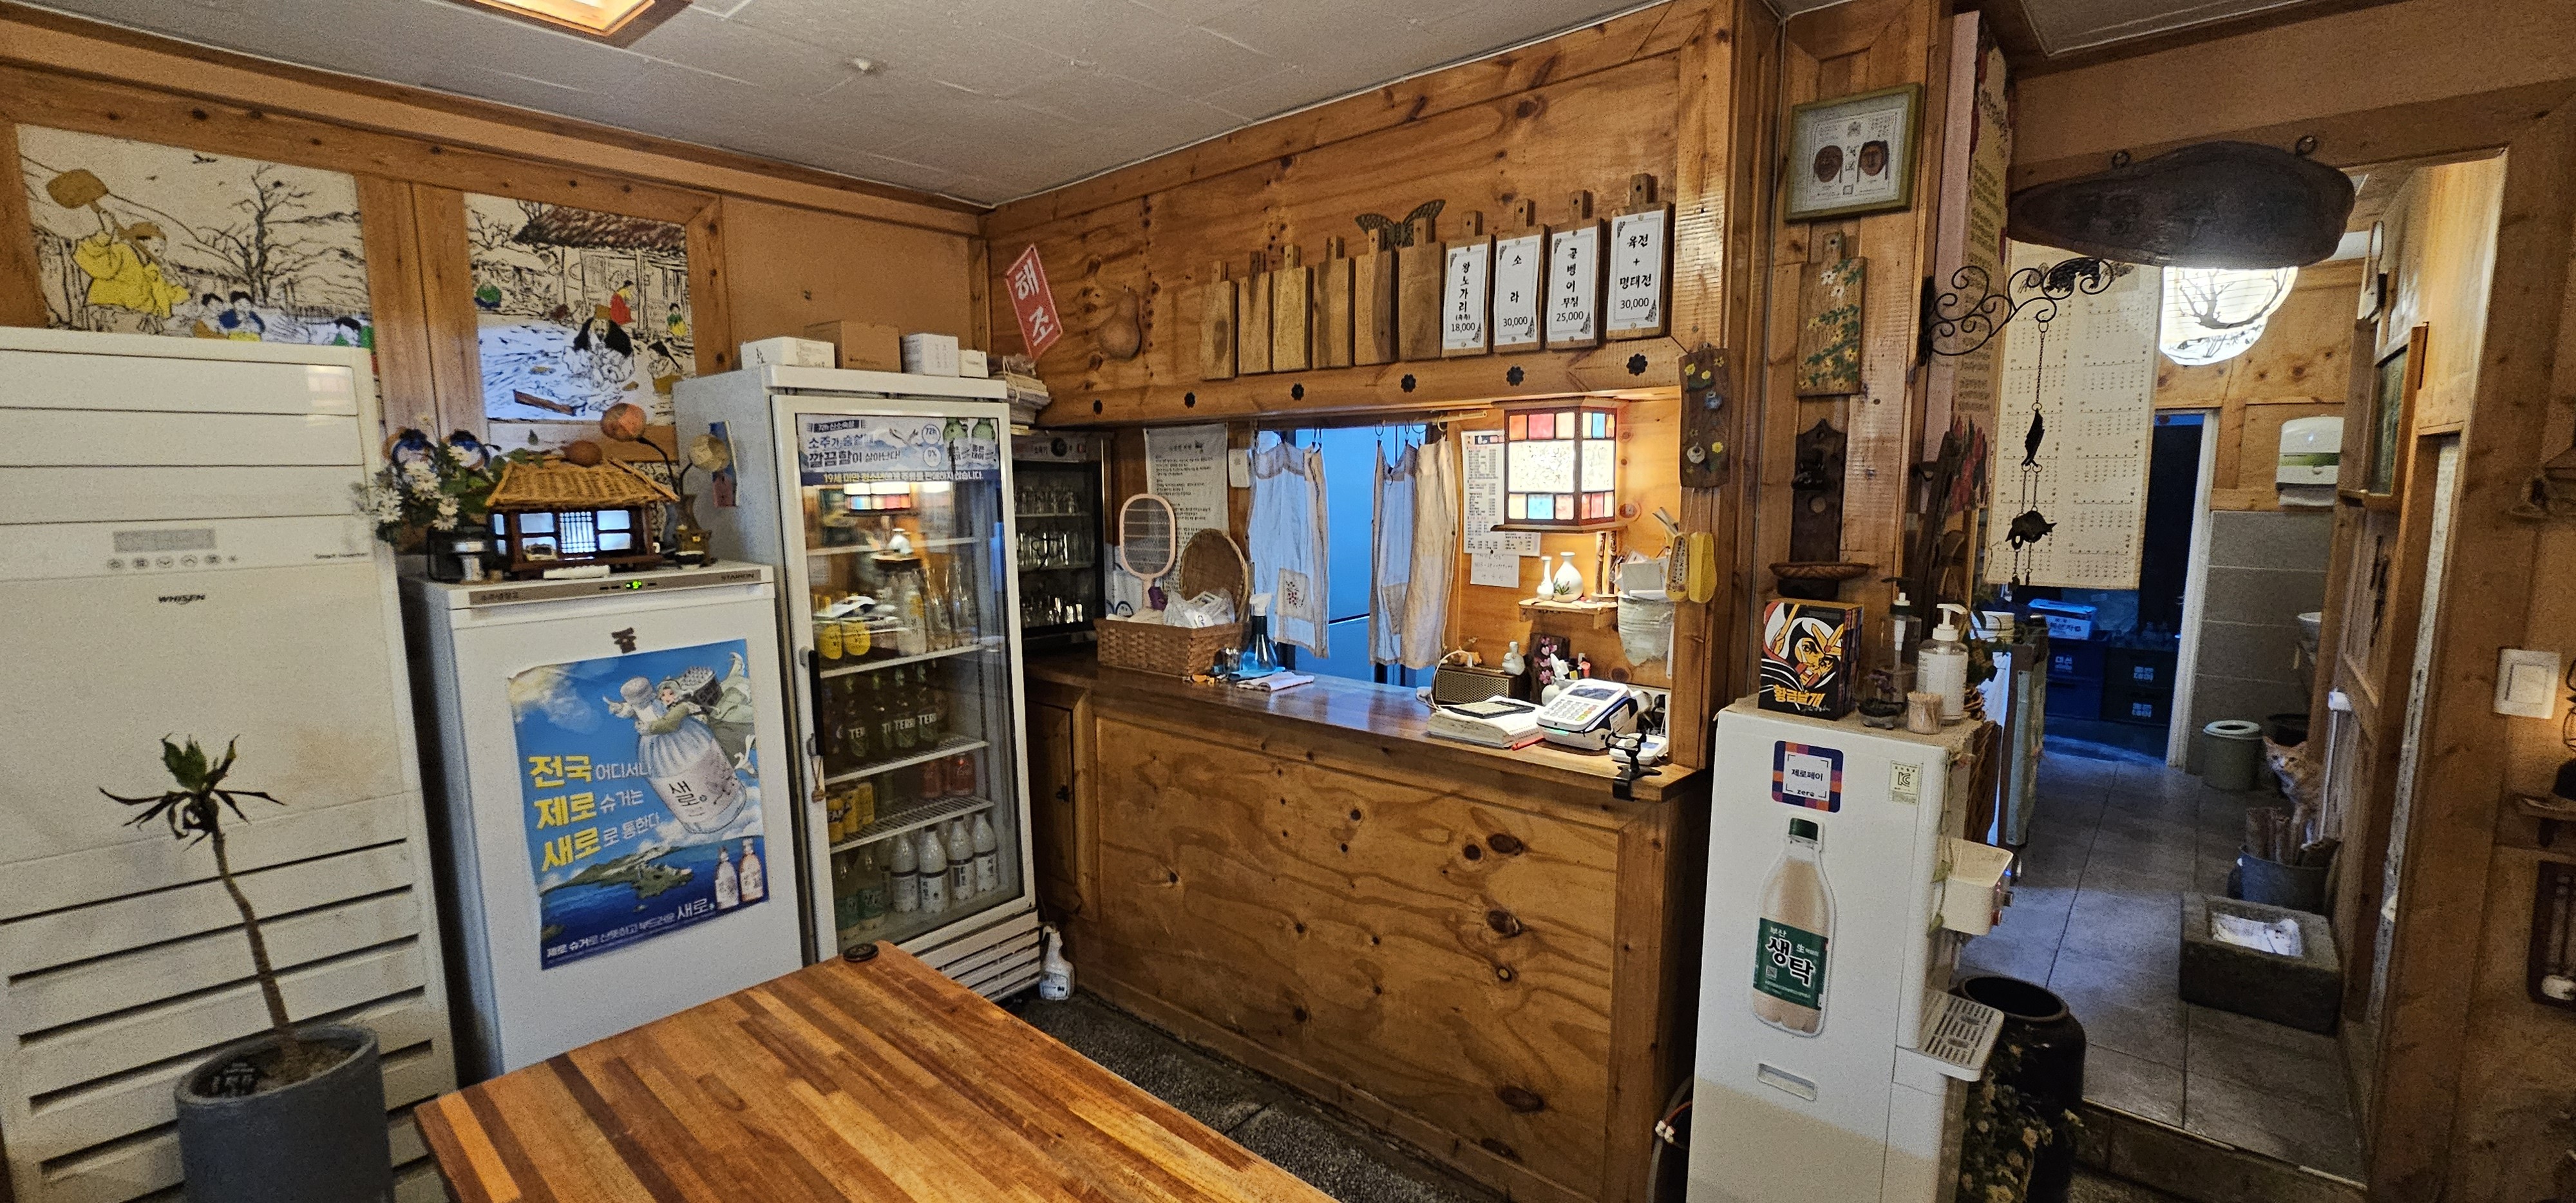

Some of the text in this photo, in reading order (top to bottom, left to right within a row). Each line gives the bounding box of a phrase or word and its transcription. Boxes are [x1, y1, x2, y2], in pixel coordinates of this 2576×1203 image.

[1627, 234, 1649, 249] 육전
[1459, 261, 1470, 313] 왕노가리
[1016, 259, 1054, 346] 해조
[1561, 296, 1578, 308] 무침
[1620, 297, 1649, 310] 30,000
[1503, 316, 1528, 328] 30,000
[1556, 310, 1584, 323] 25,000
[1452, 323, 1475, 333] 18,000
[808, 435, 839, 450] 소주가
[158, 594, 205, 605] WHISEN
[1773, 684, 1826, 708] 황금날개
[528, 755, 652, 788] 전국 어디서나
[1792, 768, 1823, 781] 제로페이
[668, 780, 700, 806] 새로
[534, 789, 644, 829] 제로 슈거는
[542, 826, 601, 872] 새로
[621, 812, 660, 840] 통한다
[547, 943, 568, 958] 제로
[677, 898, 708, 920] 새로
[1765, 936, 1816, 988] 생탁
